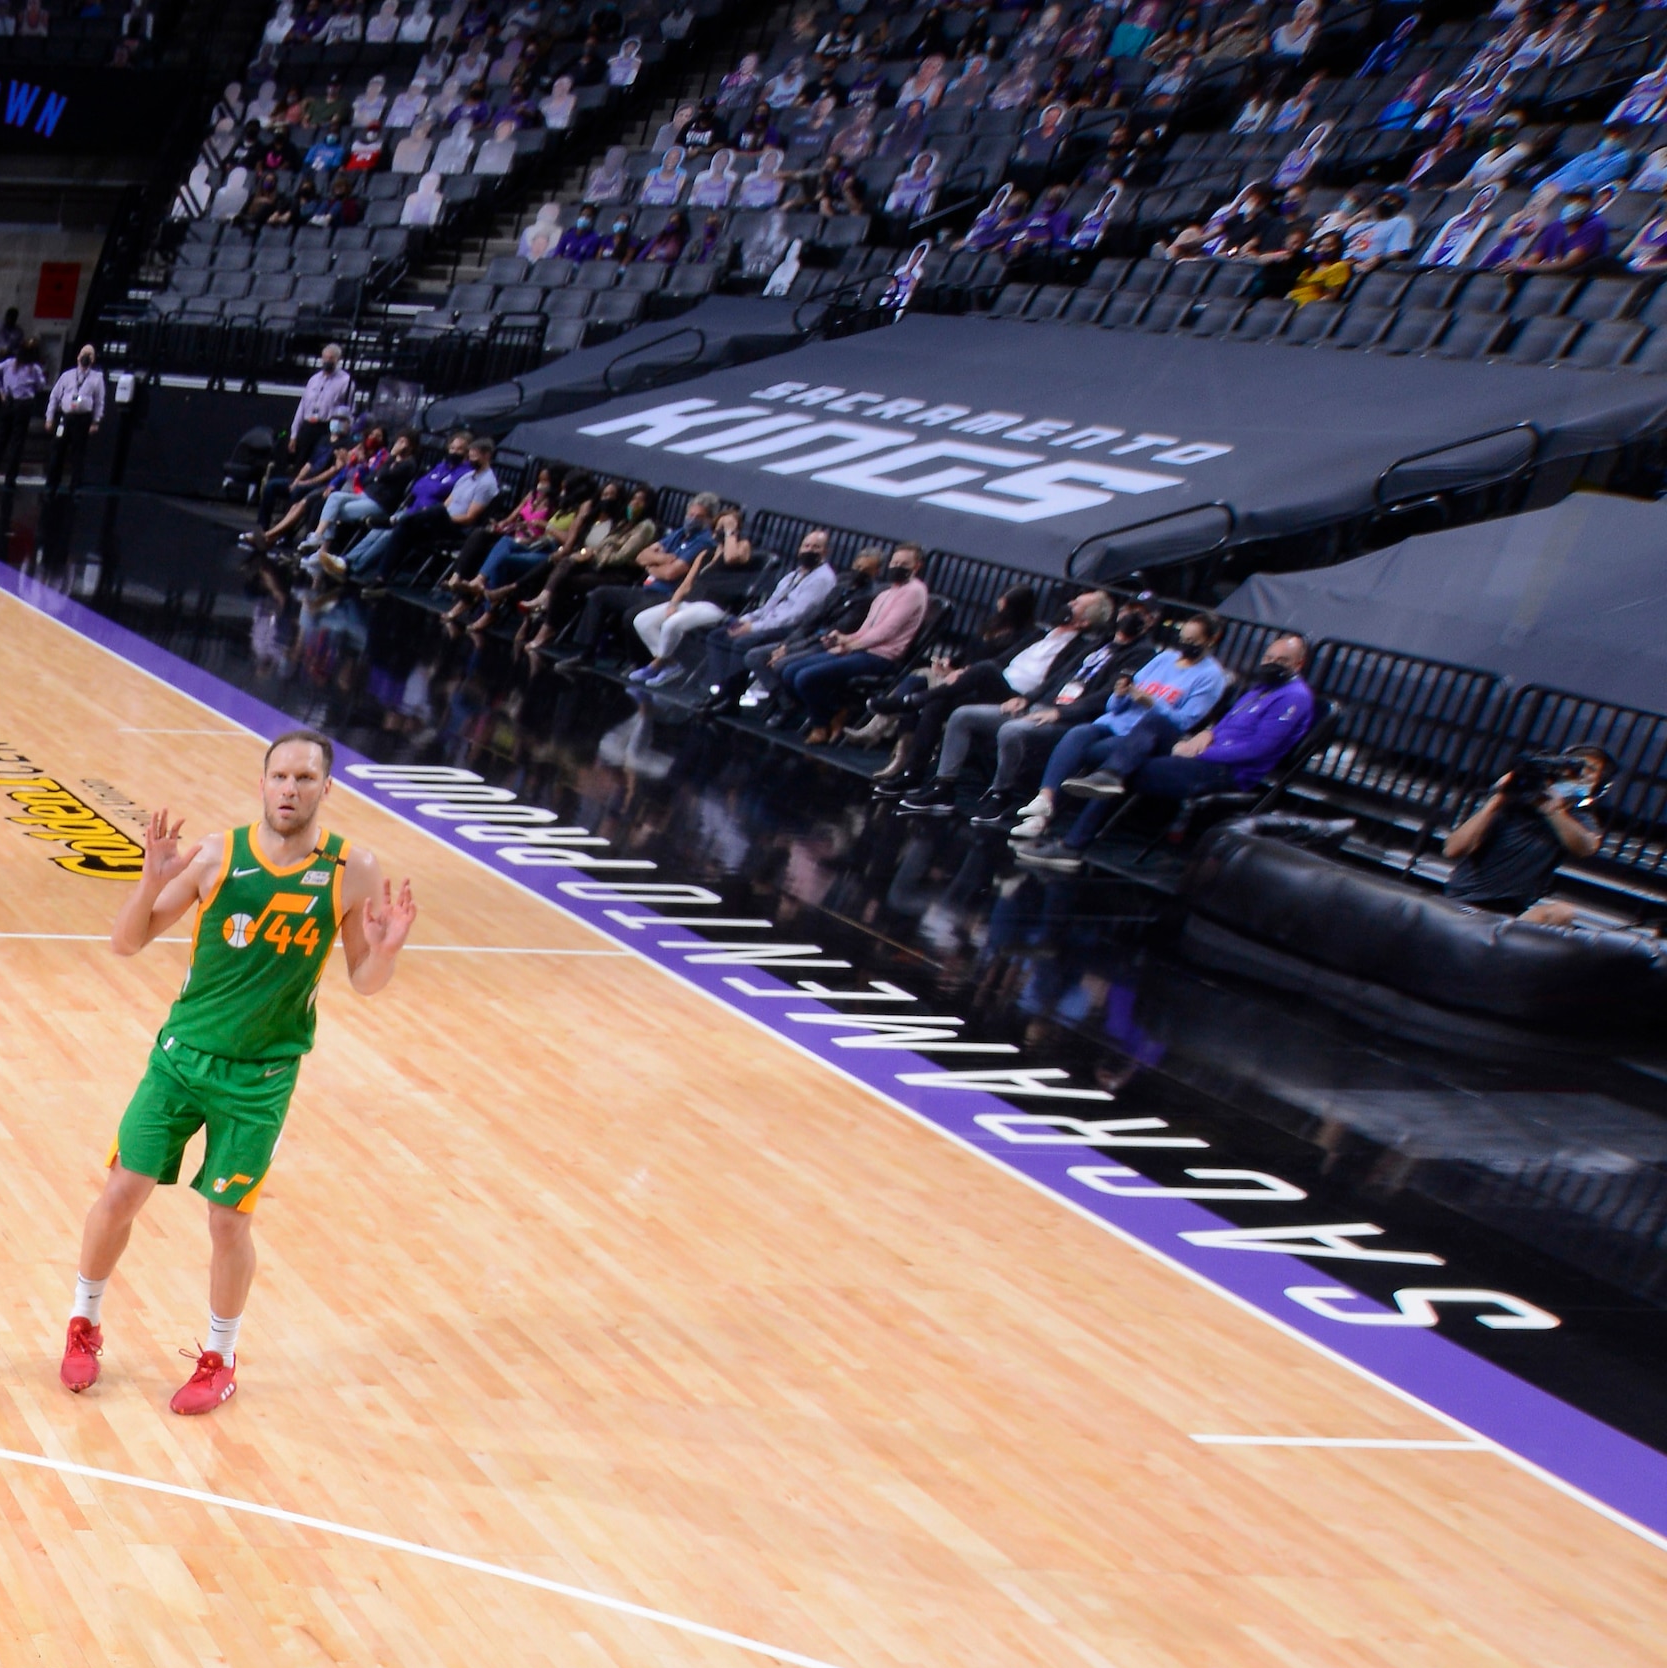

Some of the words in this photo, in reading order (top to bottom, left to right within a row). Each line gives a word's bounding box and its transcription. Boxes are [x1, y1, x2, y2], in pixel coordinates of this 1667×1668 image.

[576, 398, 1187, 523] KINGS
[750, 381, 1237, 467] SACRAMENTO
[344, 763, 659, 870] PROUD
[264, 914, 320, 956] 44
[556, 881, 1563, 1332] SACRAMENTO
